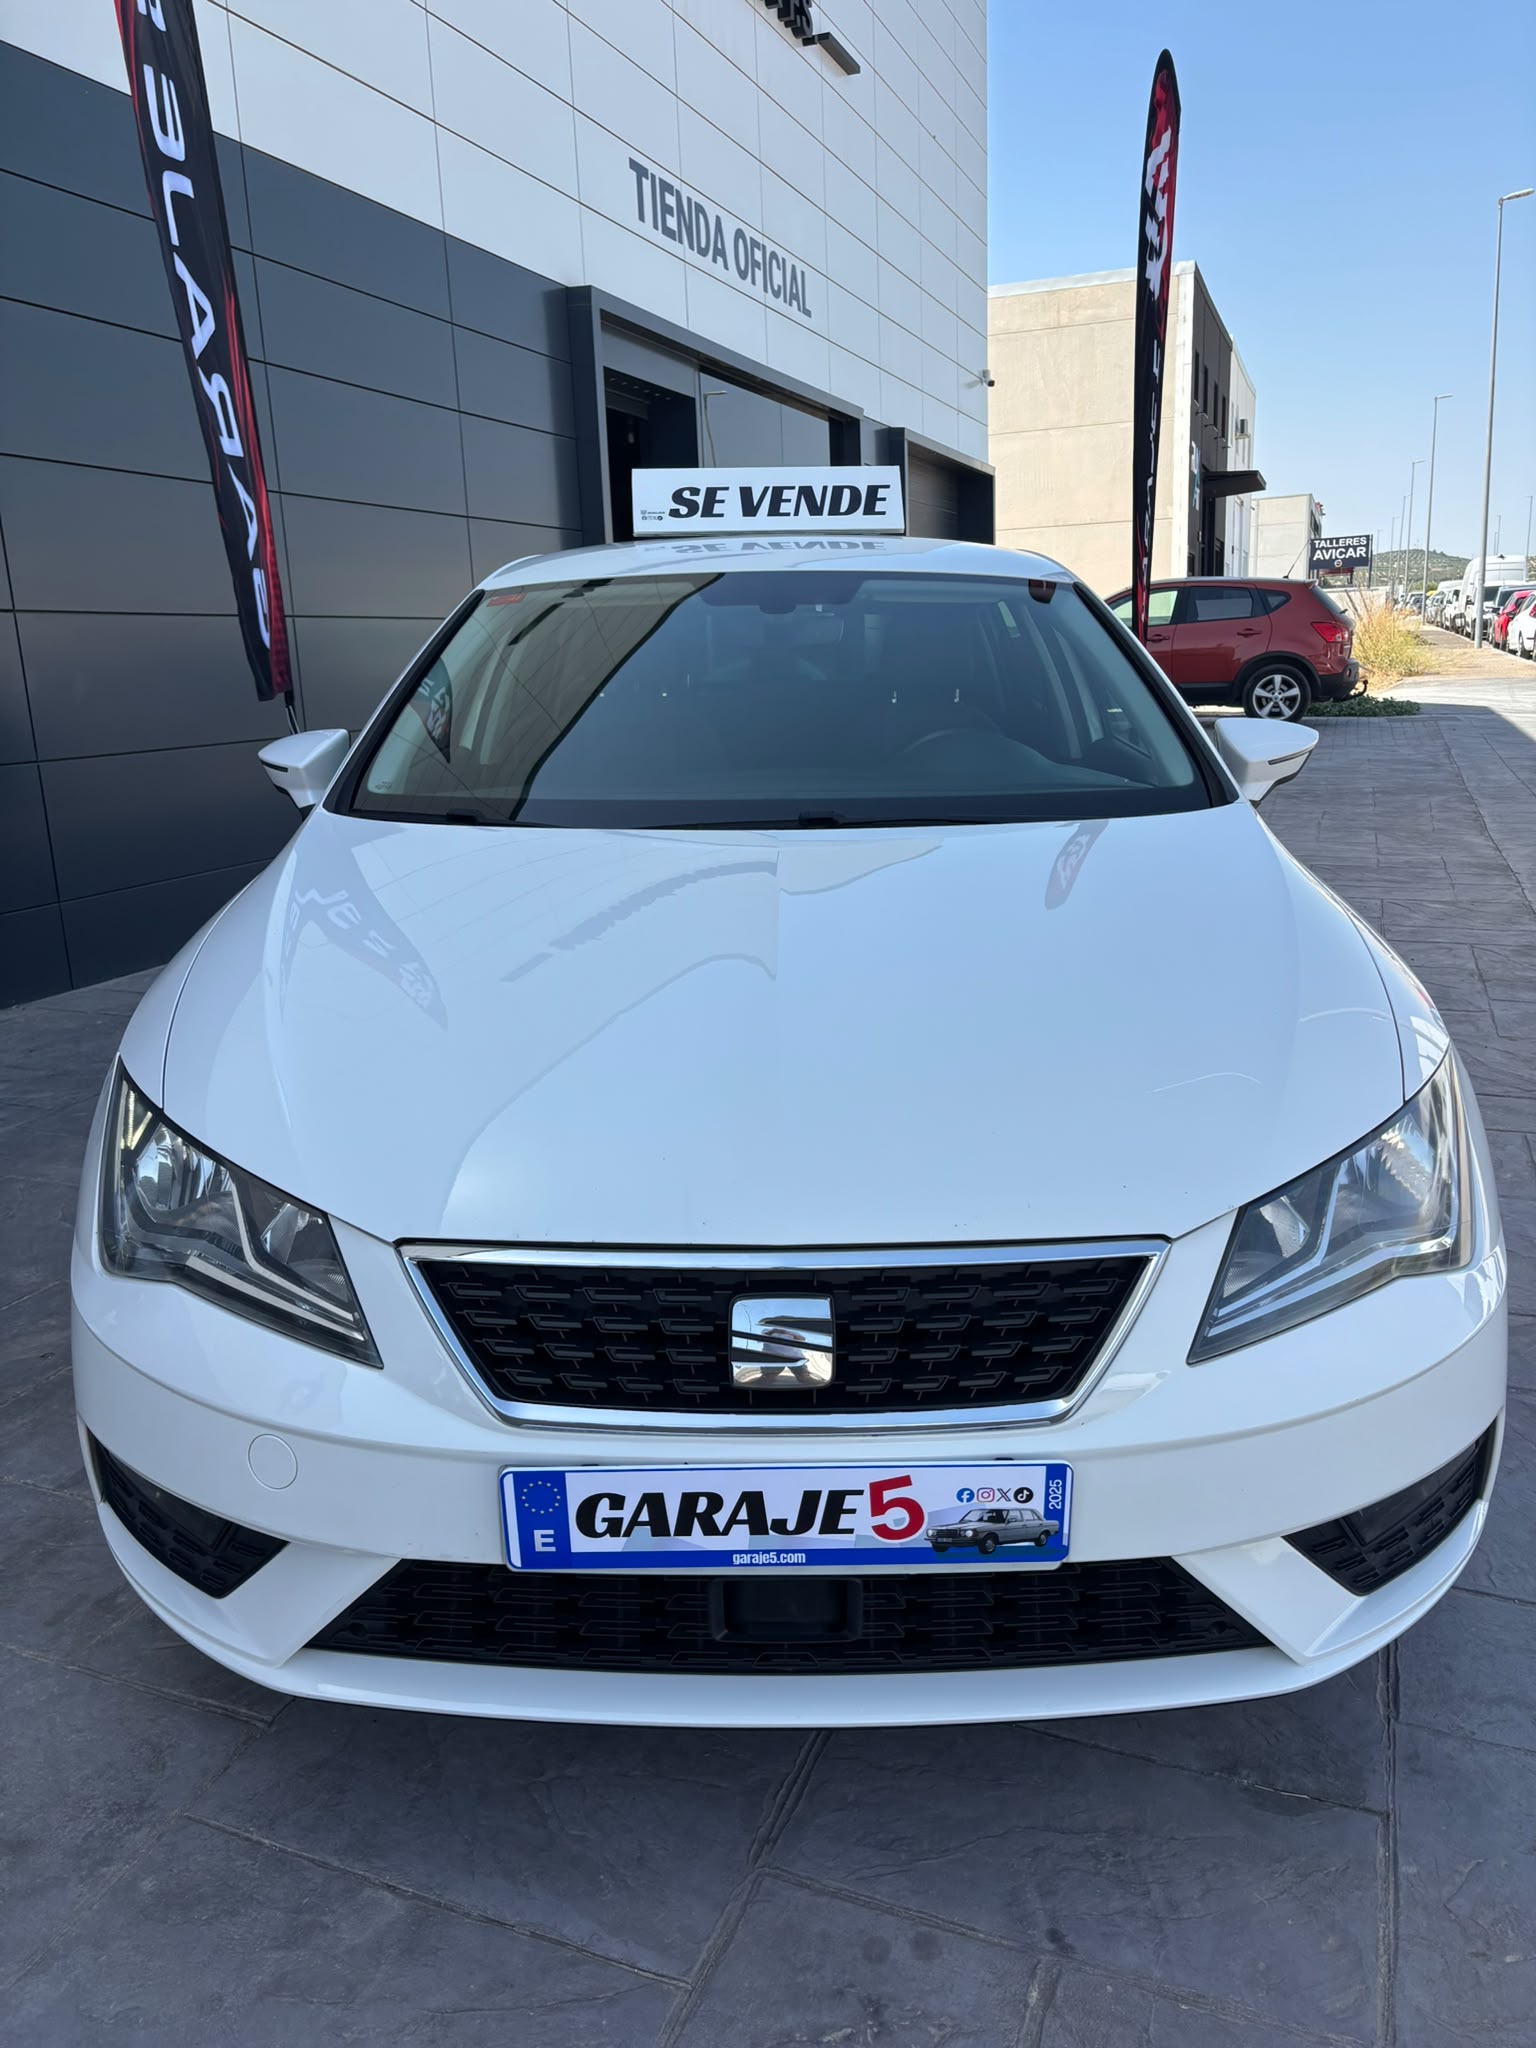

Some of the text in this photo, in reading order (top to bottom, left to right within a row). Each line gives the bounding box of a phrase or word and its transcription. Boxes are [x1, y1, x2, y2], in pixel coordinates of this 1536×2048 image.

[629, 157, 812, 318] TIENDA OFICIAL
[668, 484, 891, 518] SE VENDE
[1313, 547, 1367, 561] AVICAR
[1314, 537, 1367, 548] TALLERES
[1048, 1479, 1062, 1510] 2025
[533, 1529, 557, 1552] E
[732, 1551, 806, 1565] garaje5.com
